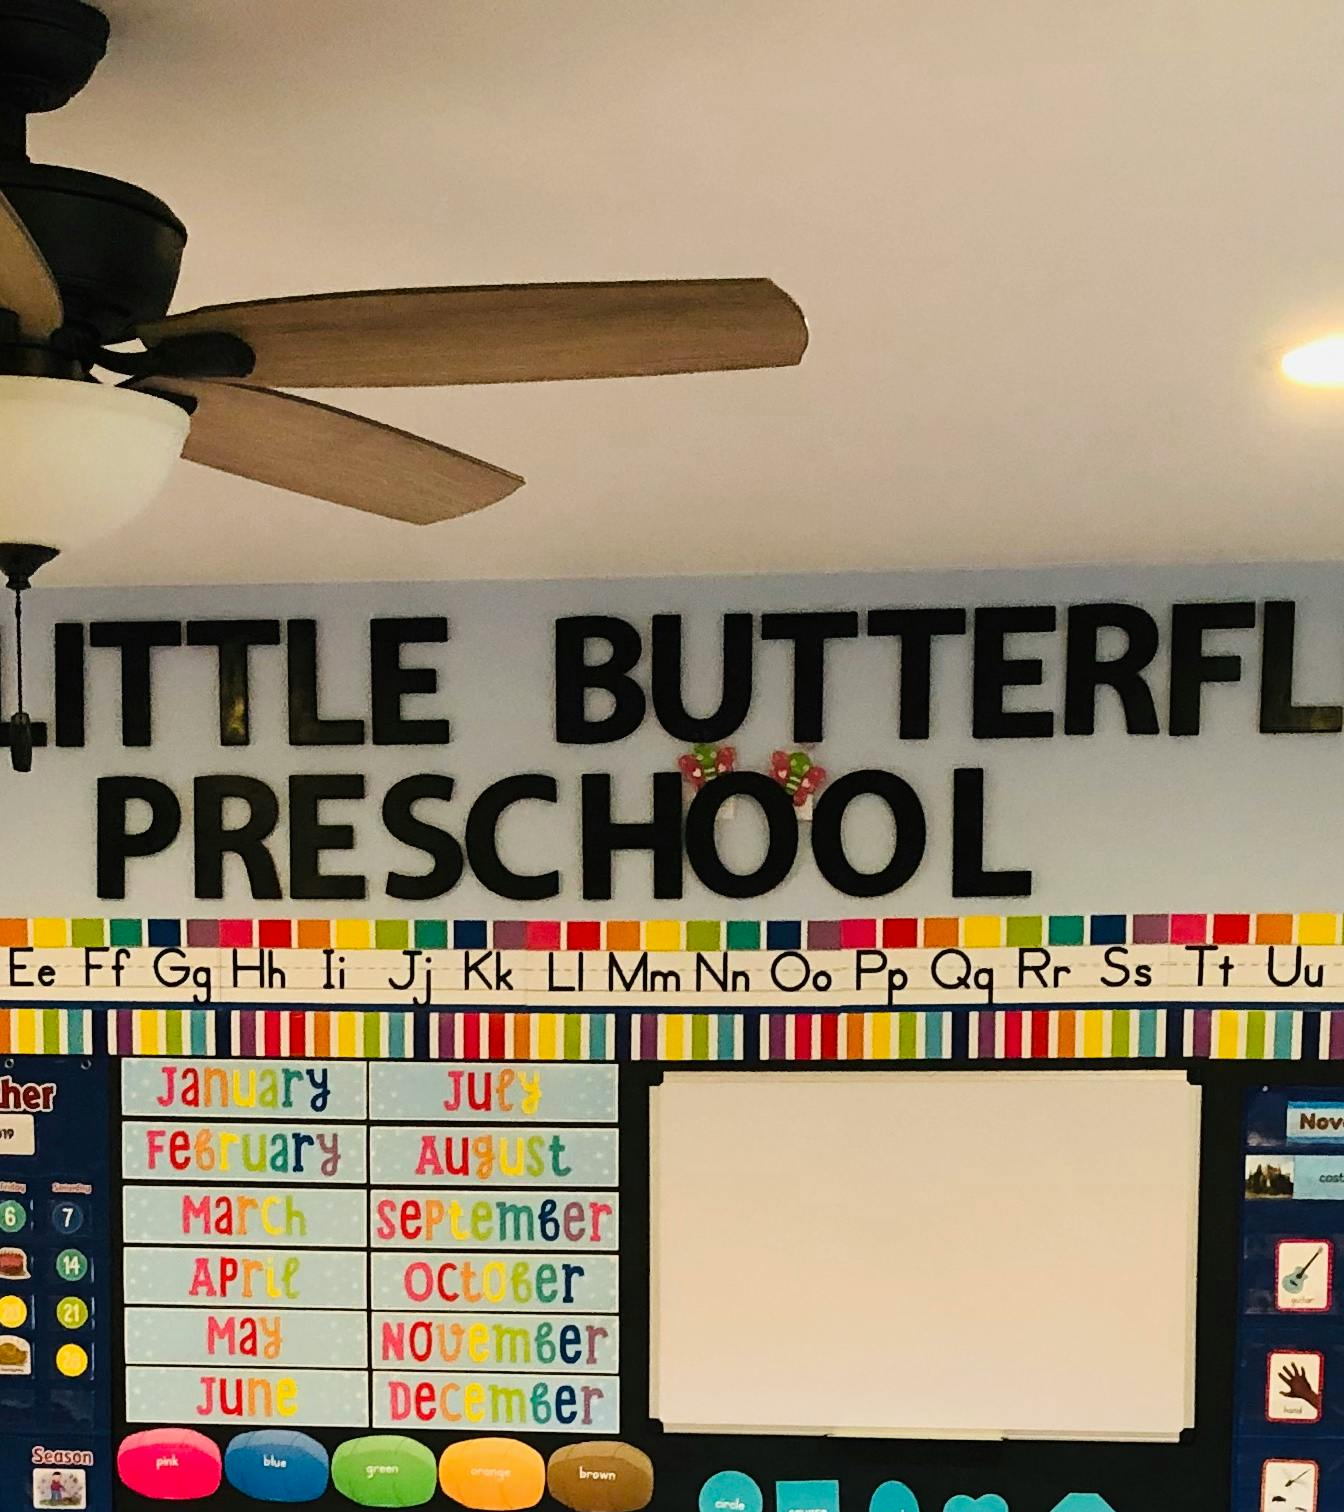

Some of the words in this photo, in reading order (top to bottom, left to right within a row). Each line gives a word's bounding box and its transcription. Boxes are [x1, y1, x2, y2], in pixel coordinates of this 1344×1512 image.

[96, 766, 1033, 900] PRESCHOOL
[9, 947, 56, 988] Ee
[85, 947, 131, 988] Ff
[153, 948, 212, 1004] Gg
[232, 948, 286, 989] Hh
[322, 949, 346, 989] Ii
[388, 950, 432, 1006] Jj
[463, 950, 513, 991] Kk
[548, 951, 585, 991] Ll
[608, 951, 681, 992] Mm
[695, 952, 750, 992] Nn
[770, 951, 832, 992] Oo
[856, 950, 909, 1006] Pp
[931, 948, 994, 1006] Qq
[1018, 947, 1071, 988] Rr
[1100, 946, 1152, 988] Ss
[1185, 945, 1234, 988] Tt
[1268, 945, 1324, 988] Uu
[156, 1066, 331, 1113] January
[443, 1067, 543, 1115] July
[145, 1128, 342, 1176] February
[415, 1133, 572, 1180] August
[4, 1206, 16, 1226] 6
[61, 1207, 74, 1228] 7
[181, 1195, 308, 1237] March
[375, 1199, 613, 1241] September
[63, 1256, 81, 1276] 14
[188, 1256, 302, 1299] April
[403, 1260, 585, 1304] October
[63, 1303, 80, 1322] 21
[206, 1315, 284, 1359] May
[381, 1320, 609, 1365] November
[196, 1376, 298, 1417] June
[388, 1381, 604, 1424] December
[32, 1446, 93, 1465] Season
[156, 1456, 180, 1470] pink
[263, 1454, 287, 1468] blue
[365, 1464, 399, 1479] green
[470, 1467, 512, 1481] orange
[579, 1466, 617, 1481] brown
[714, 1498, 746, 1512] circle
